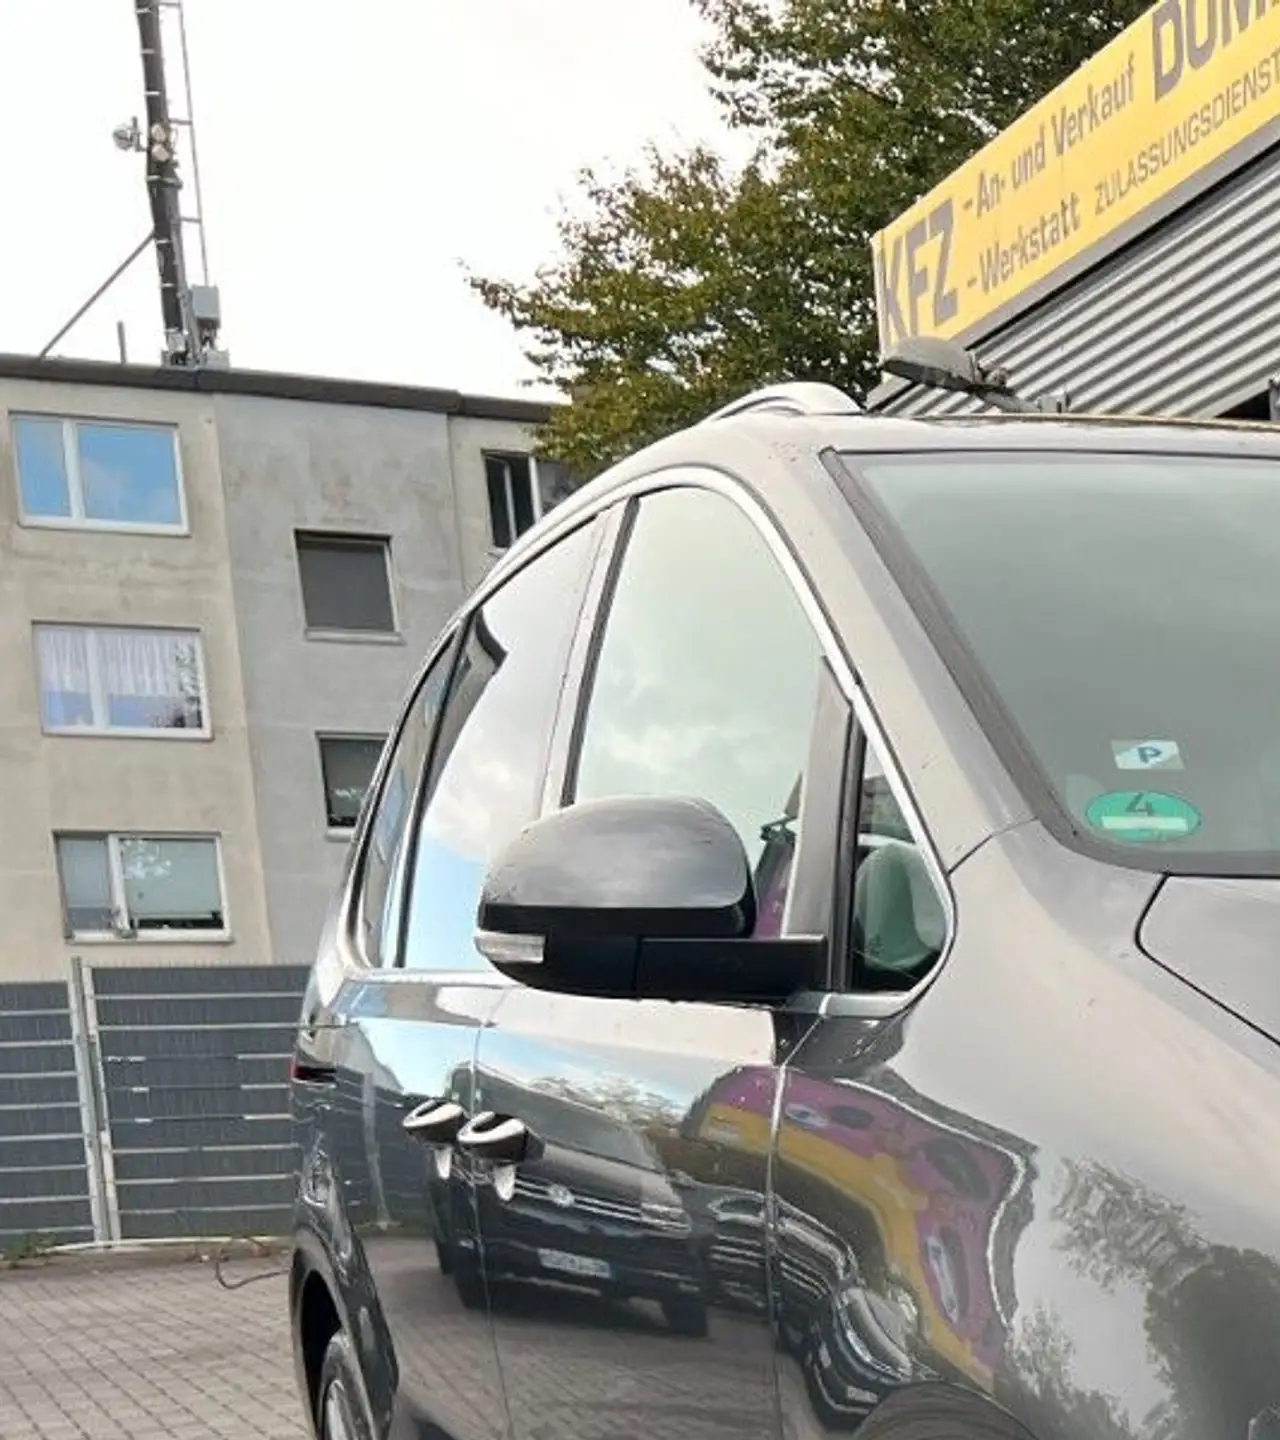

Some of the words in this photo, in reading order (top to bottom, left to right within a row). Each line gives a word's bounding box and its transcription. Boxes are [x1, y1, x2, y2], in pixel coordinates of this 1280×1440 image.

[1152, 0, 1280, 104] DO
[1012, 121, 1046, 190] und
[1051, 51, 1135, 157] Verkauf
[879, 197, 958, 346] KFZ
[1125, 791, 1155, 817] 4
